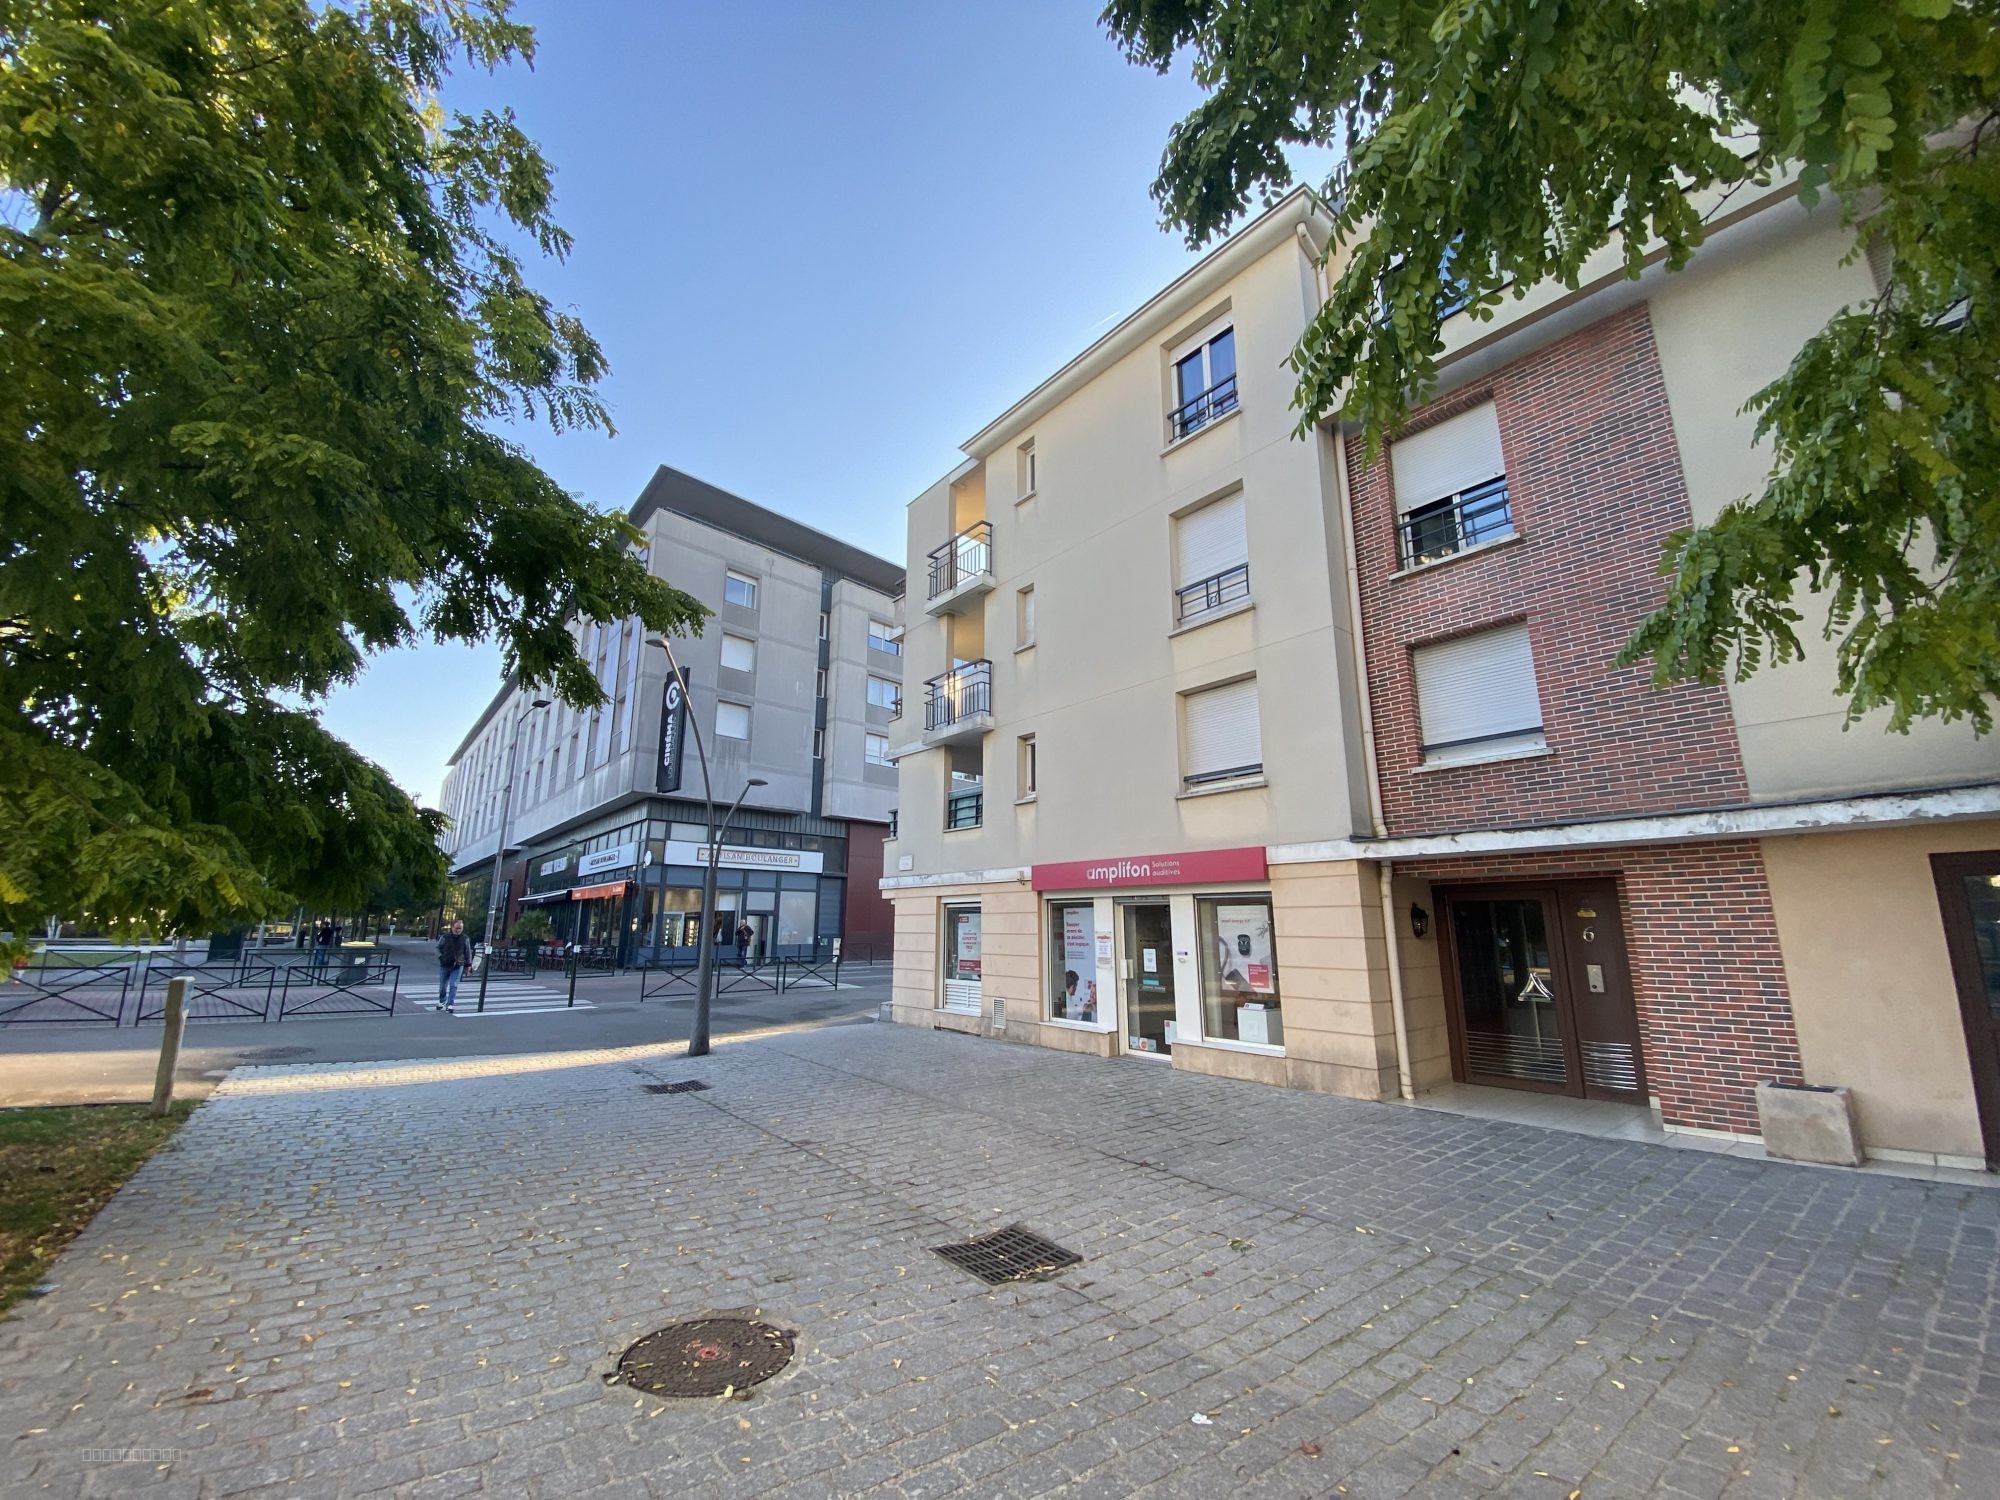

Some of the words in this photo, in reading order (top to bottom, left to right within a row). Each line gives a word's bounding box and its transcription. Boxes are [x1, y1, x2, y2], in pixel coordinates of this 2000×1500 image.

[664, 714, 673, 766] CINÉMA
[745, 853, 793, 864] BOULANGER
[1152, 860, 1180, 868] Solutions
[1086, 861, 1150, 884] amplifon
[1152, 868, 1181, 877] auditives
[1582, 926, 1595, 942] 6
